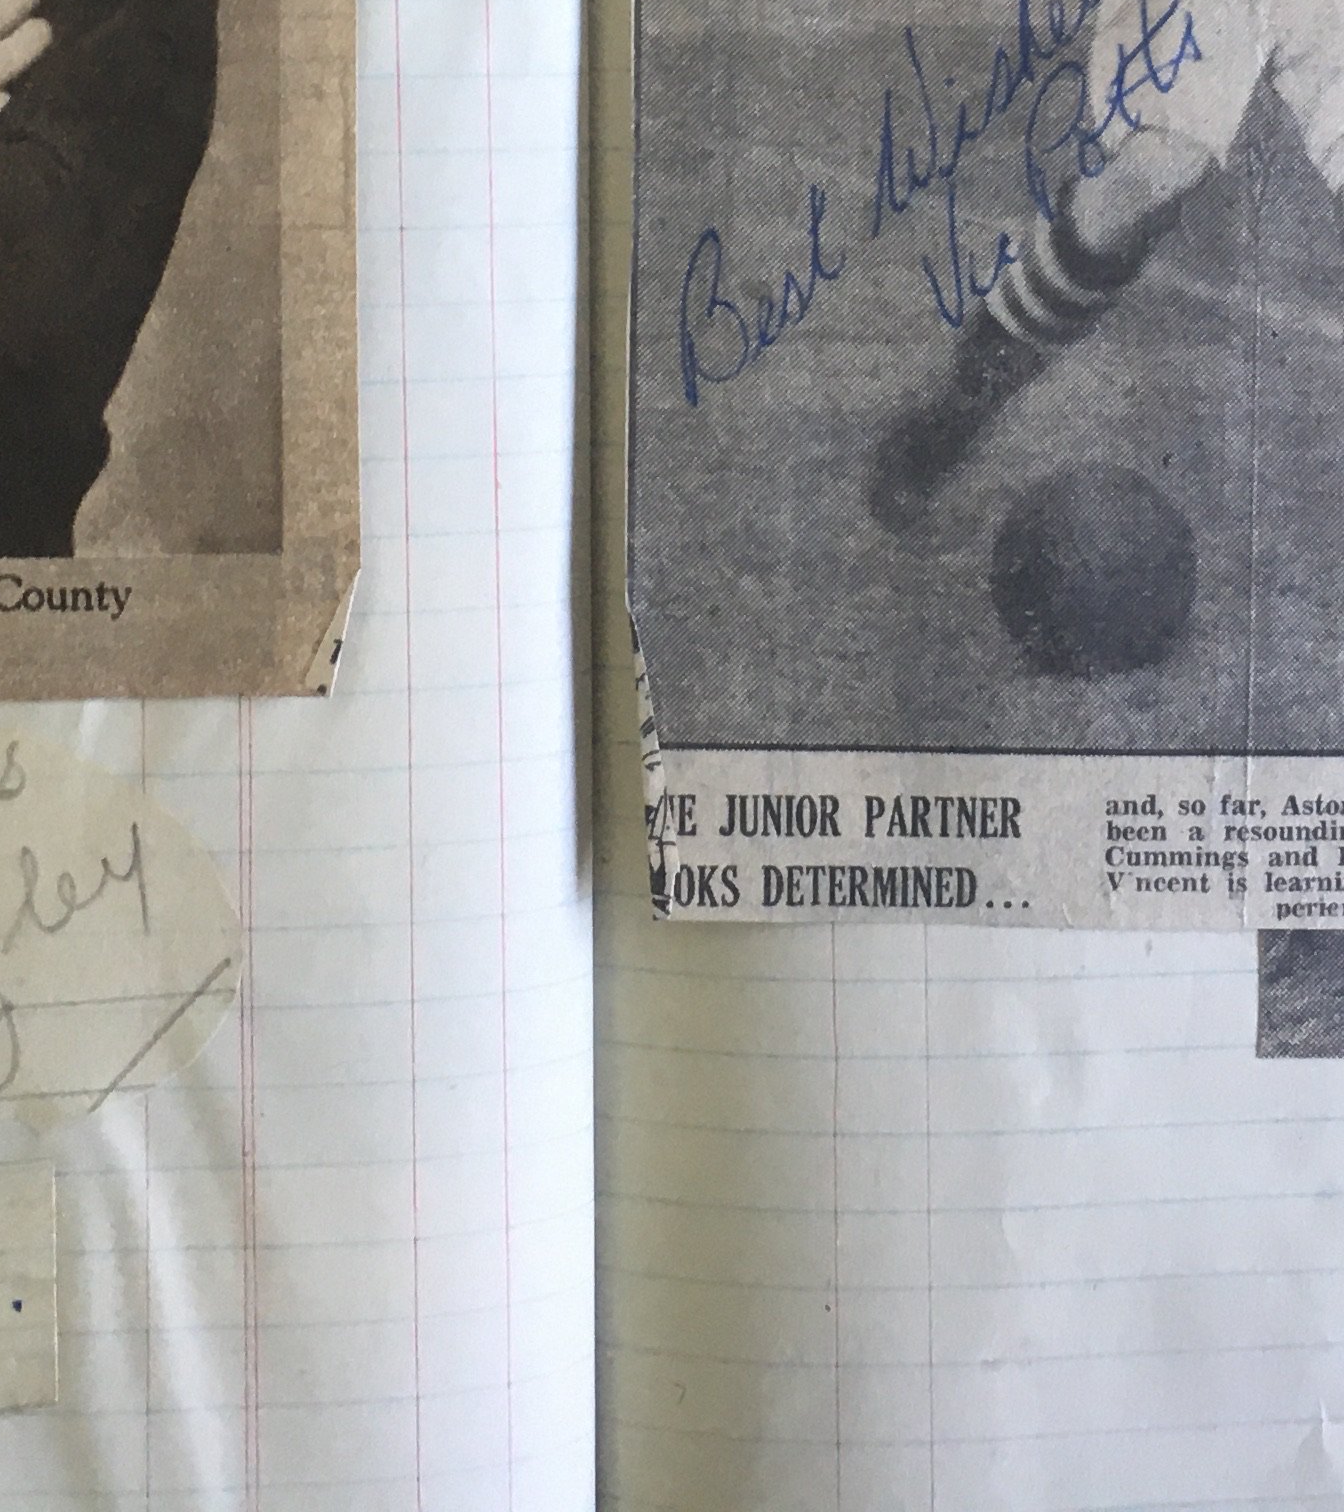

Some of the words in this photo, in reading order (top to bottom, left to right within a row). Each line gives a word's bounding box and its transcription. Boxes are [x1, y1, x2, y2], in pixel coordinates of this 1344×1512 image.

[678, 183, 848, 408] Best
[718, 793, 842, 838] JUNIOR
[863, 794, 1024, 839] PARTNER
[1105, 793, 1164, 819] and,
[1177, 799, 1207, 817] so
[1218, 793, 1268, 819] far,
[1106, 819, 1168, 842] been
[1188, 825, 1205, 842] a
[1105, 845, 1250, 872] Cummings
[1267, 845, 1319, 867] and
[1228, 871, 1249, 893] is
